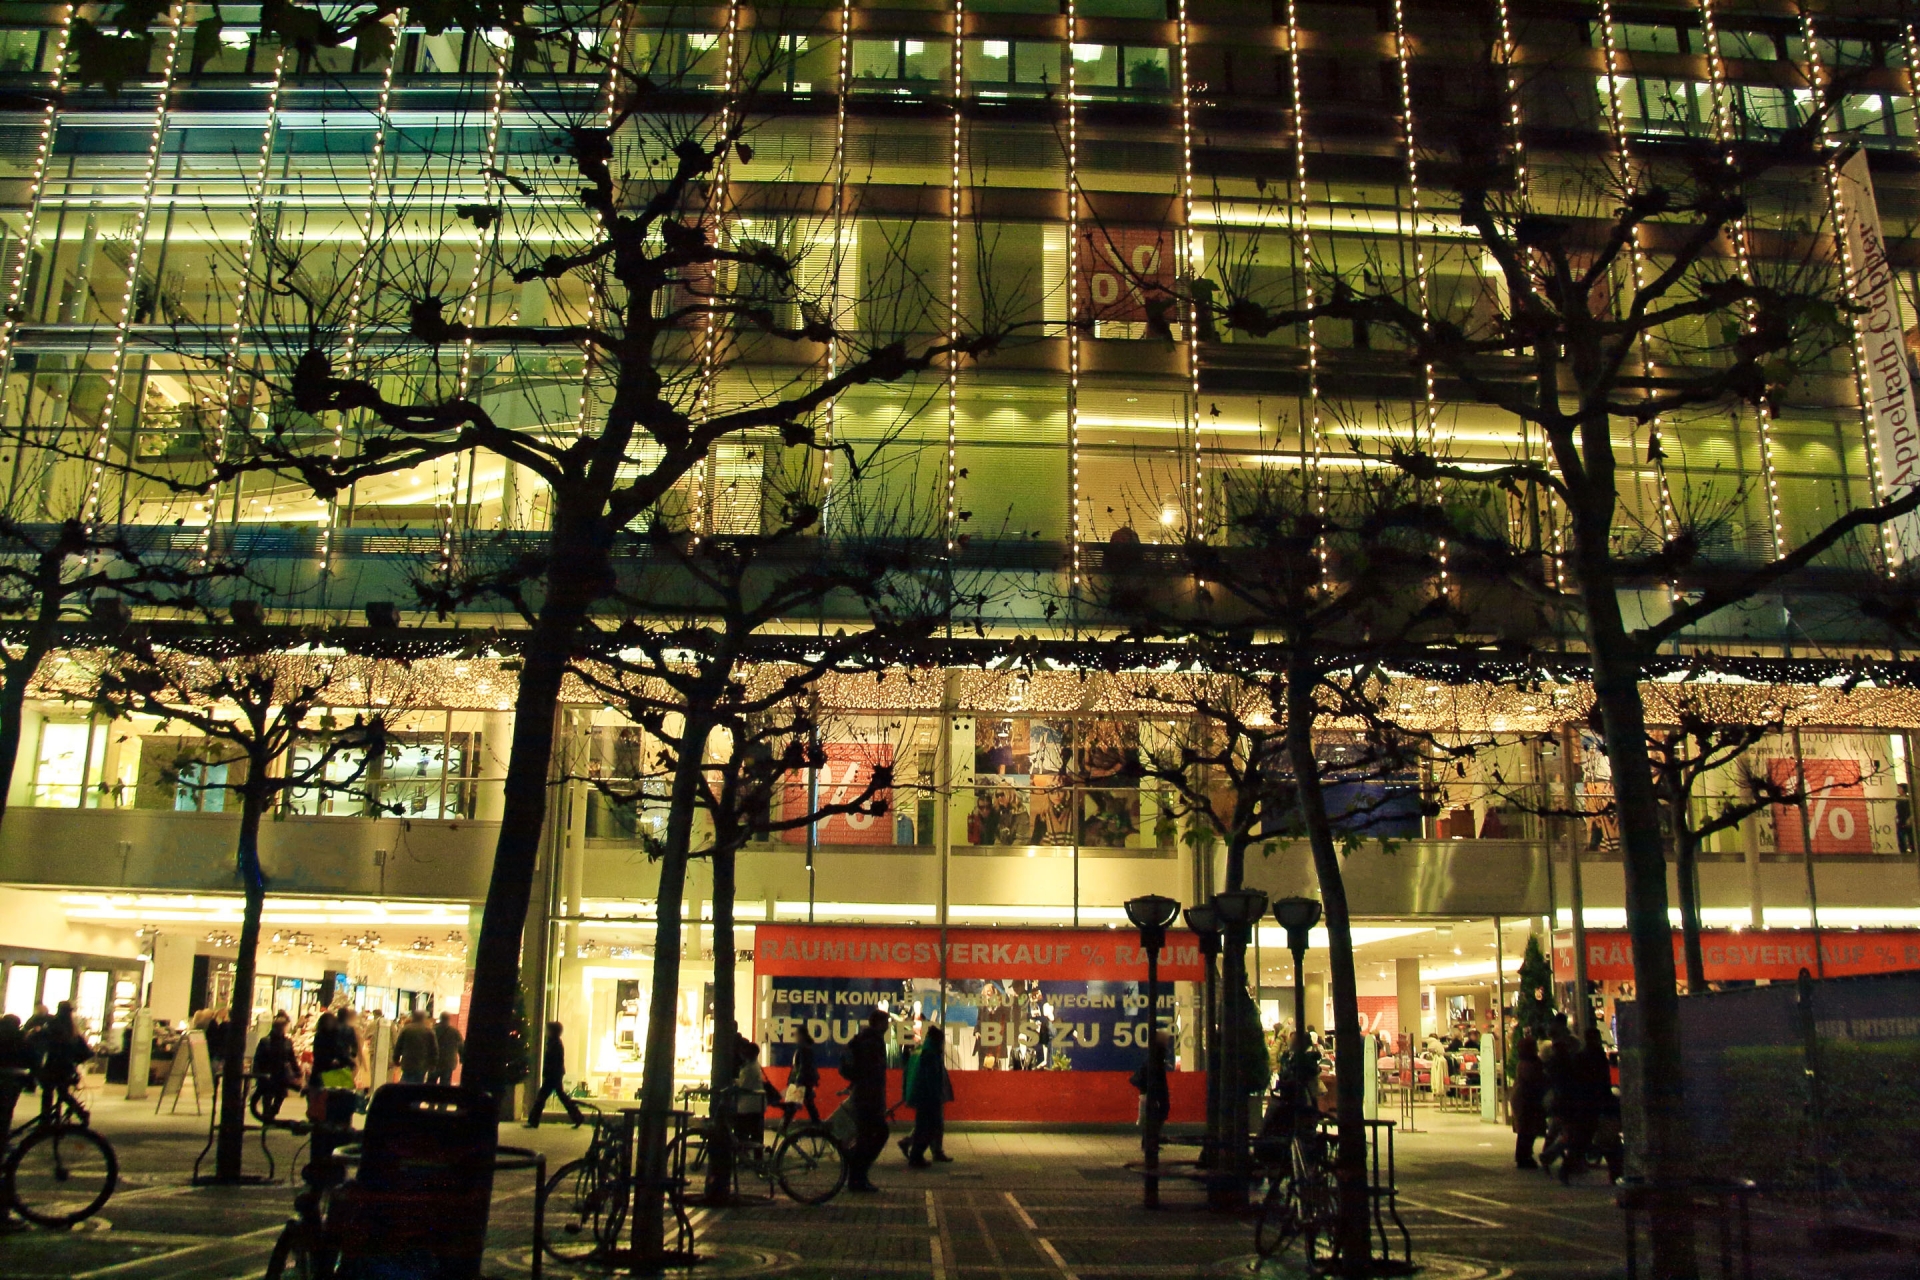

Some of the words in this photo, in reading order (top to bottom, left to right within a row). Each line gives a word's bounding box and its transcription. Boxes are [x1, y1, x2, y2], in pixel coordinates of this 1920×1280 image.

[760, 937, 1072, 965] RÄUMUNGSVERKAUF
[1047, 993, 1115, 1008] WEGEN
[980, 1021, 1040, 1047] BIS
[1052, 1022, 1099, 1048] ZU
